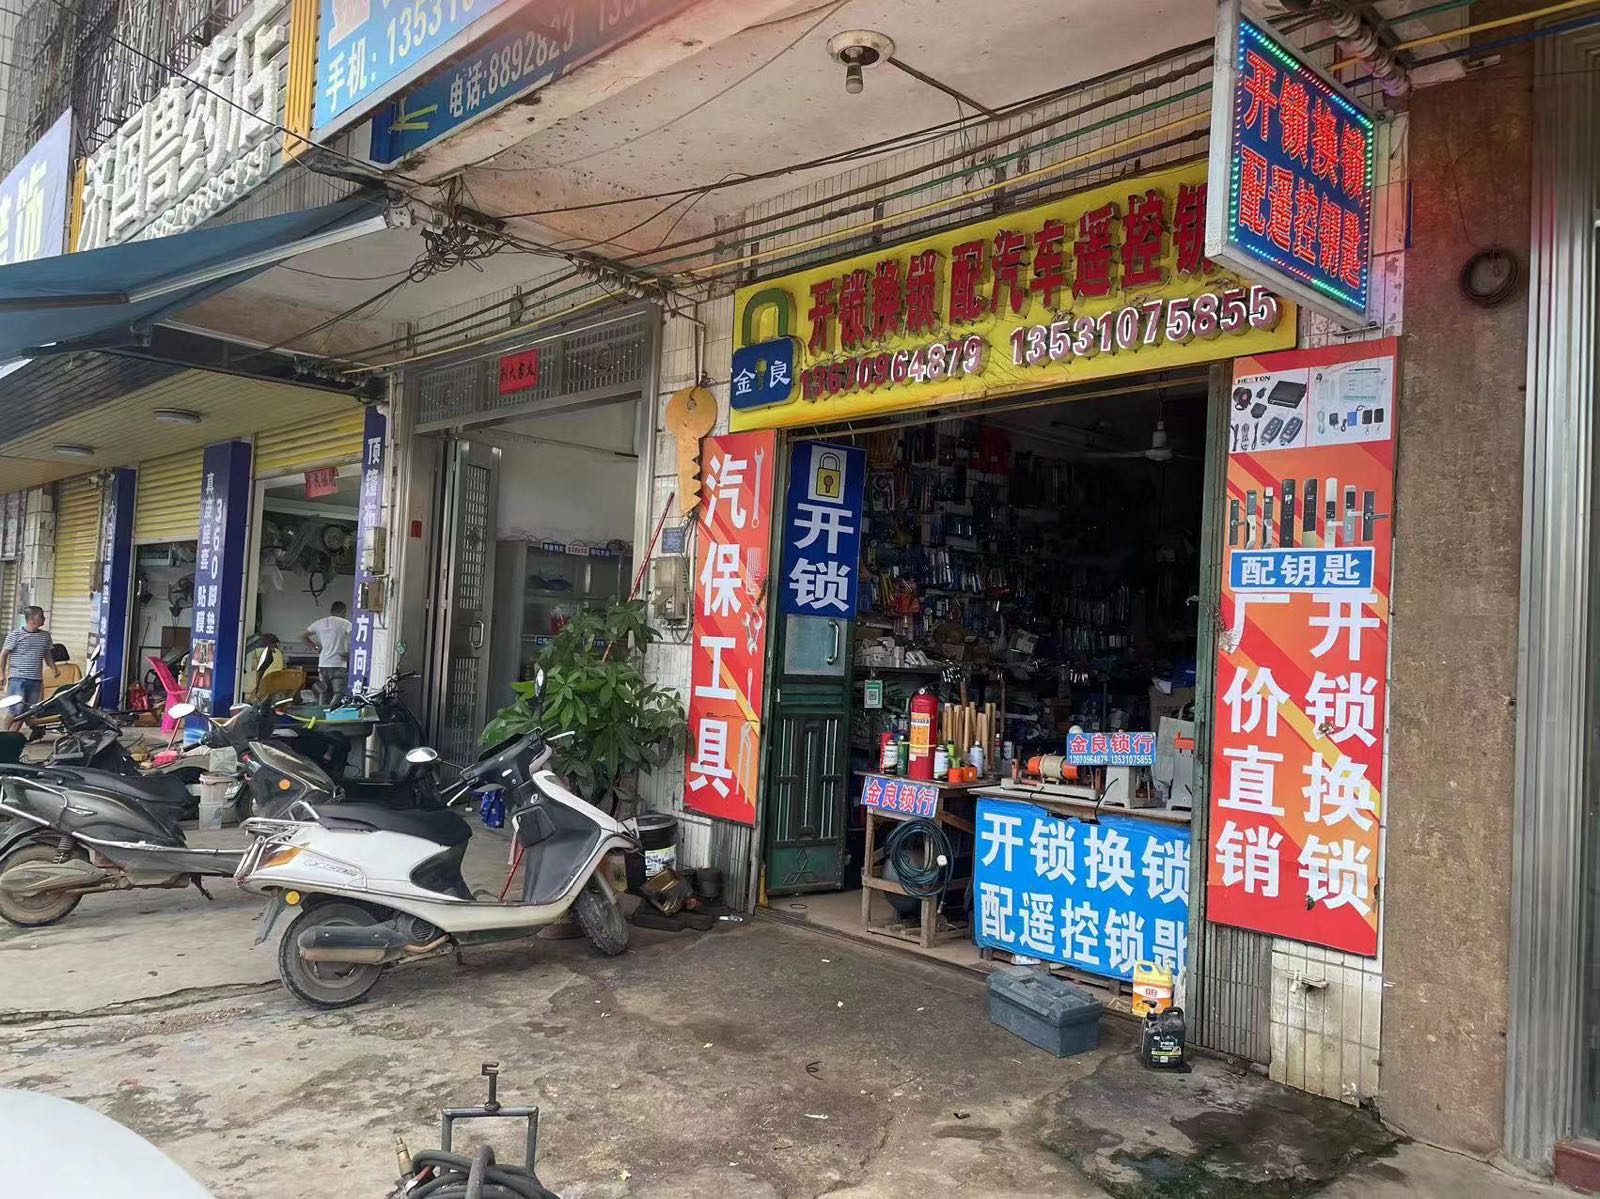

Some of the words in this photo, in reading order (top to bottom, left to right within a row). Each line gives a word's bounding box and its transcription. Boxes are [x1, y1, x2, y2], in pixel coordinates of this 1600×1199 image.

[1243, 50, 1365, 207] 开锁换锁
[1239, 145, 1361, 289] 配遥控钥匙
[733, 360, 791, 396] 金良
[801, 336, 982, 400] 13670964879
[1010, 285, 1277, 365] 13531075855
[790, 503, 854, 612] 开锁
[1242, 553, 1360, 586] 配钥匙
[689, 454, 748, 799] 汽保工具
[865, 780, 934, 815] 金良锁行
[1070, 733, 1153, 754] 金良锁行
[1111, 755, 1152, 765] 13531075855
[1216, 594, 1290, 897] 厂价直销
[1298, 593, 1380, 917] 开锁换锁
[981, 812, 1190, 906] 开锁换锁
